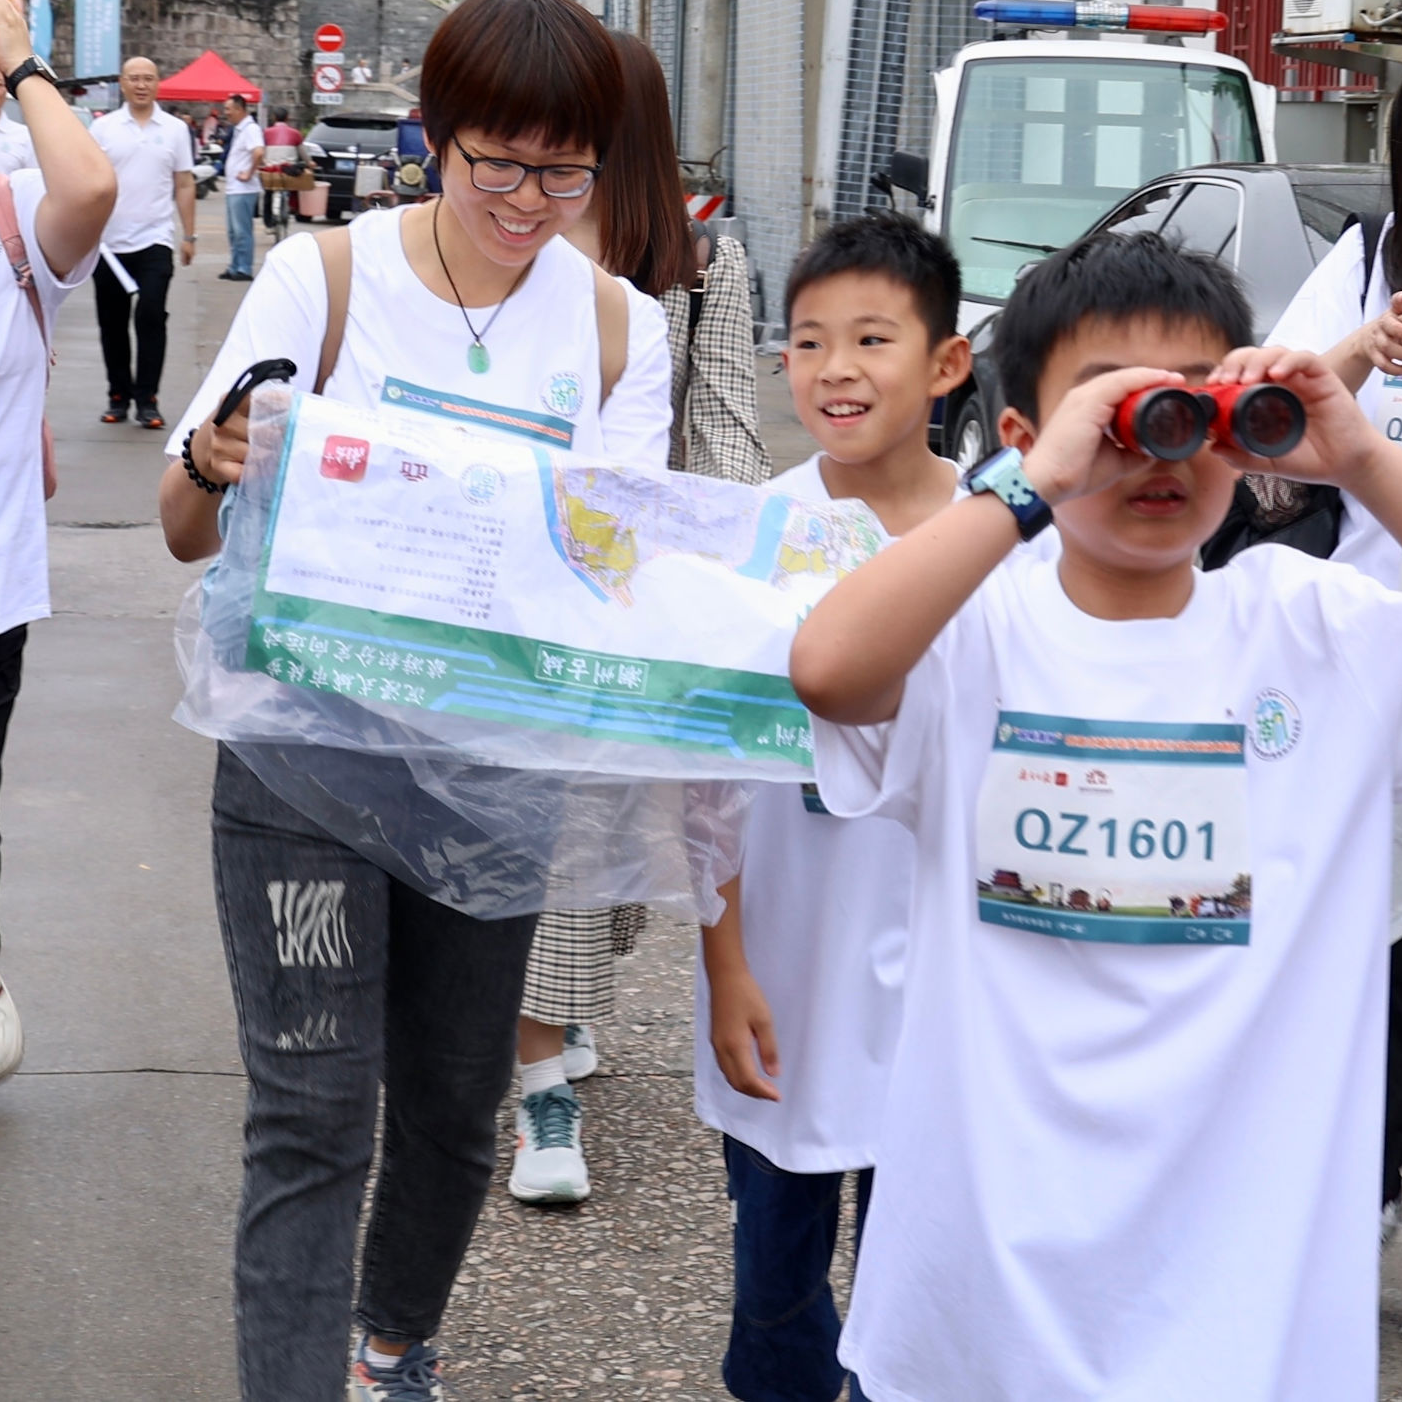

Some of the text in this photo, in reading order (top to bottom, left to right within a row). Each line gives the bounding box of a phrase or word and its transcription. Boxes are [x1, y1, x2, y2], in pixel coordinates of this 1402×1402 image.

[542, 650, 643, 689] 潮州古城
[1015, 808, 1215, 860] QZ1601
